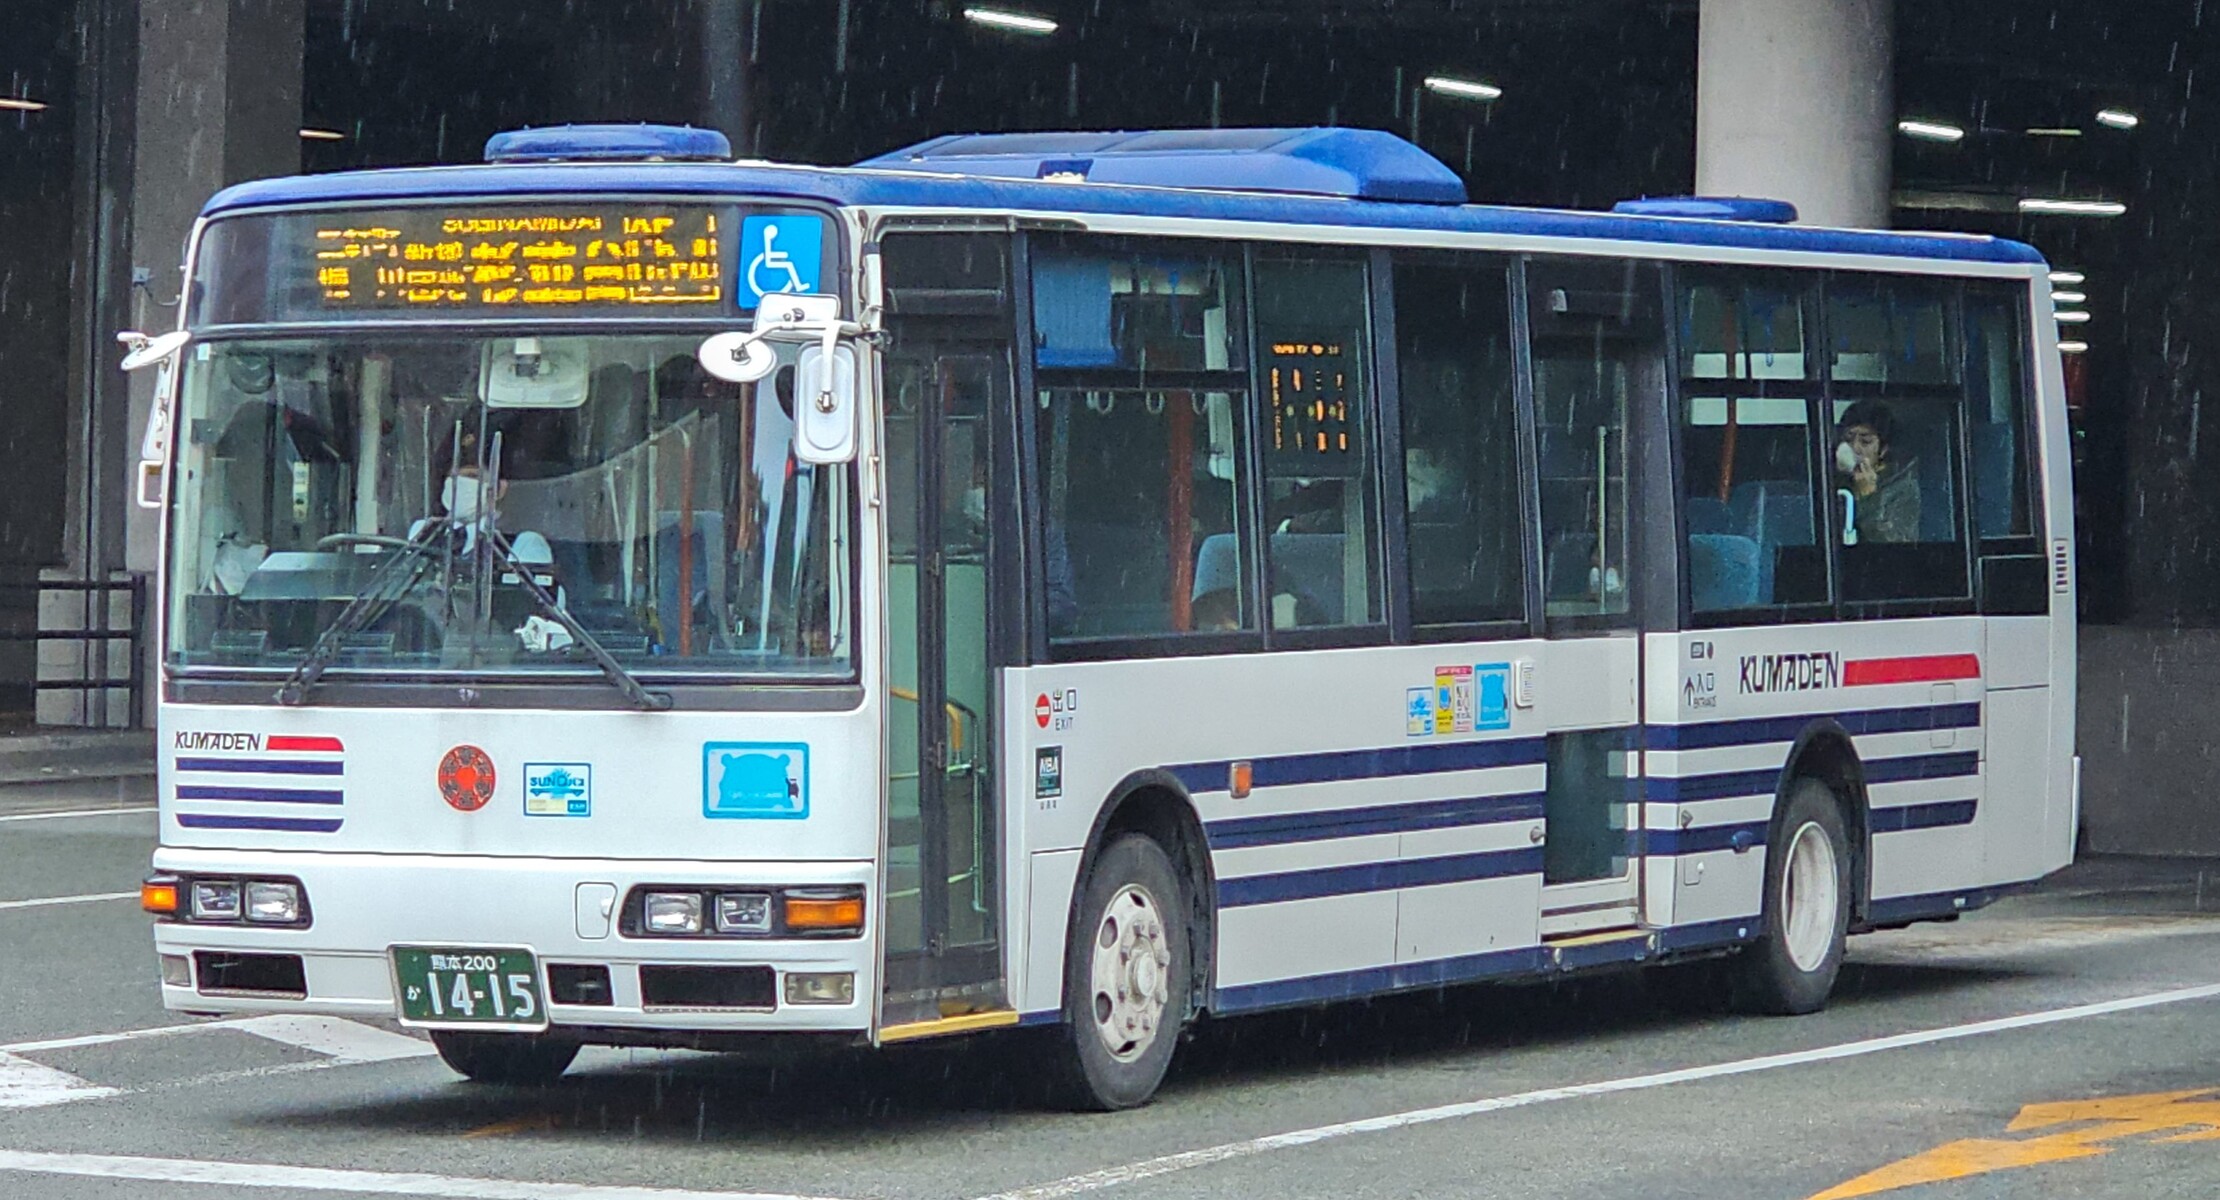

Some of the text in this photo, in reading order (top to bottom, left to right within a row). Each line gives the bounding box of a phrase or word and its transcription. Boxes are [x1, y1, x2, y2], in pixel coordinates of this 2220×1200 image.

[1739, 651, 1839, 694] KUMADEN
[1053, 689, 1076, 712] 出口
[1056, 717, 1073, 731] EXIT
[175, 731, 261, 751] KUMADEN
